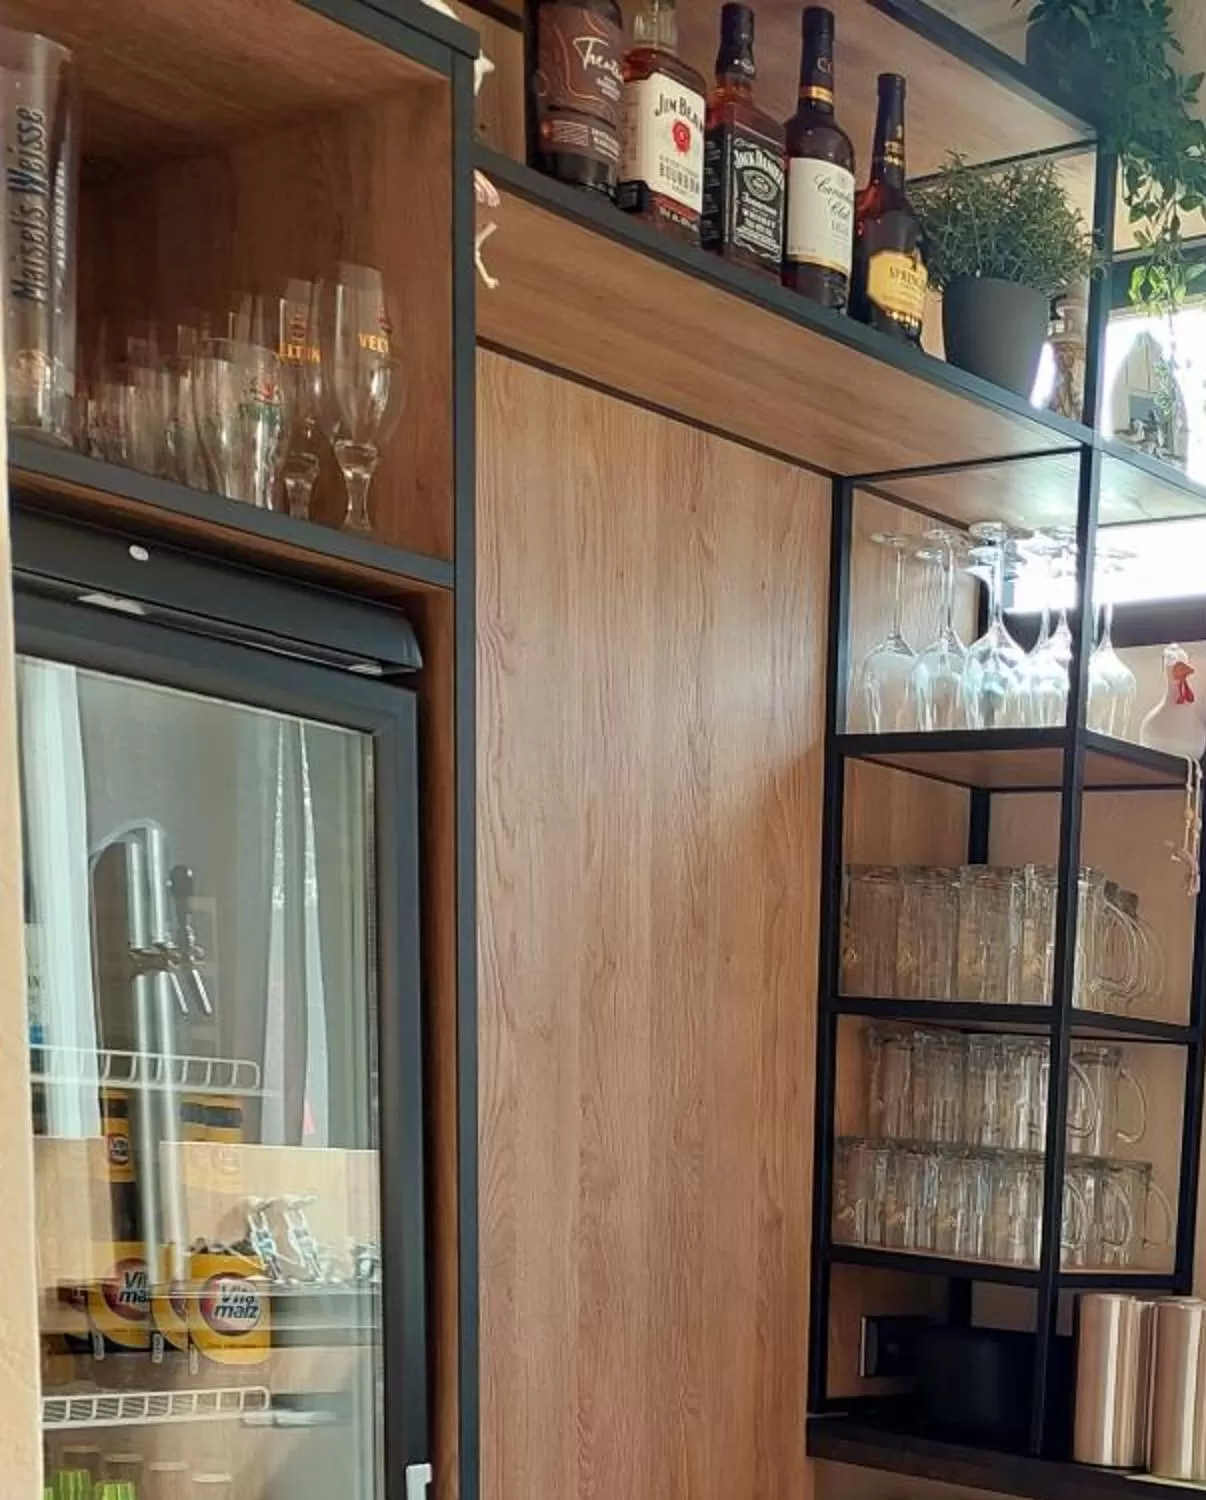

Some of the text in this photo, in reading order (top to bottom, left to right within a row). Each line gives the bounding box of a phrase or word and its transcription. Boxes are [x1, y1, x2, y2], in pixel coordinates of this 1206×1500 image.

[655, 93, 677, 117] JIM
[7, 105, 49, 304] Maisel's Weisse
[214, 1304, 259, 1319] malz
